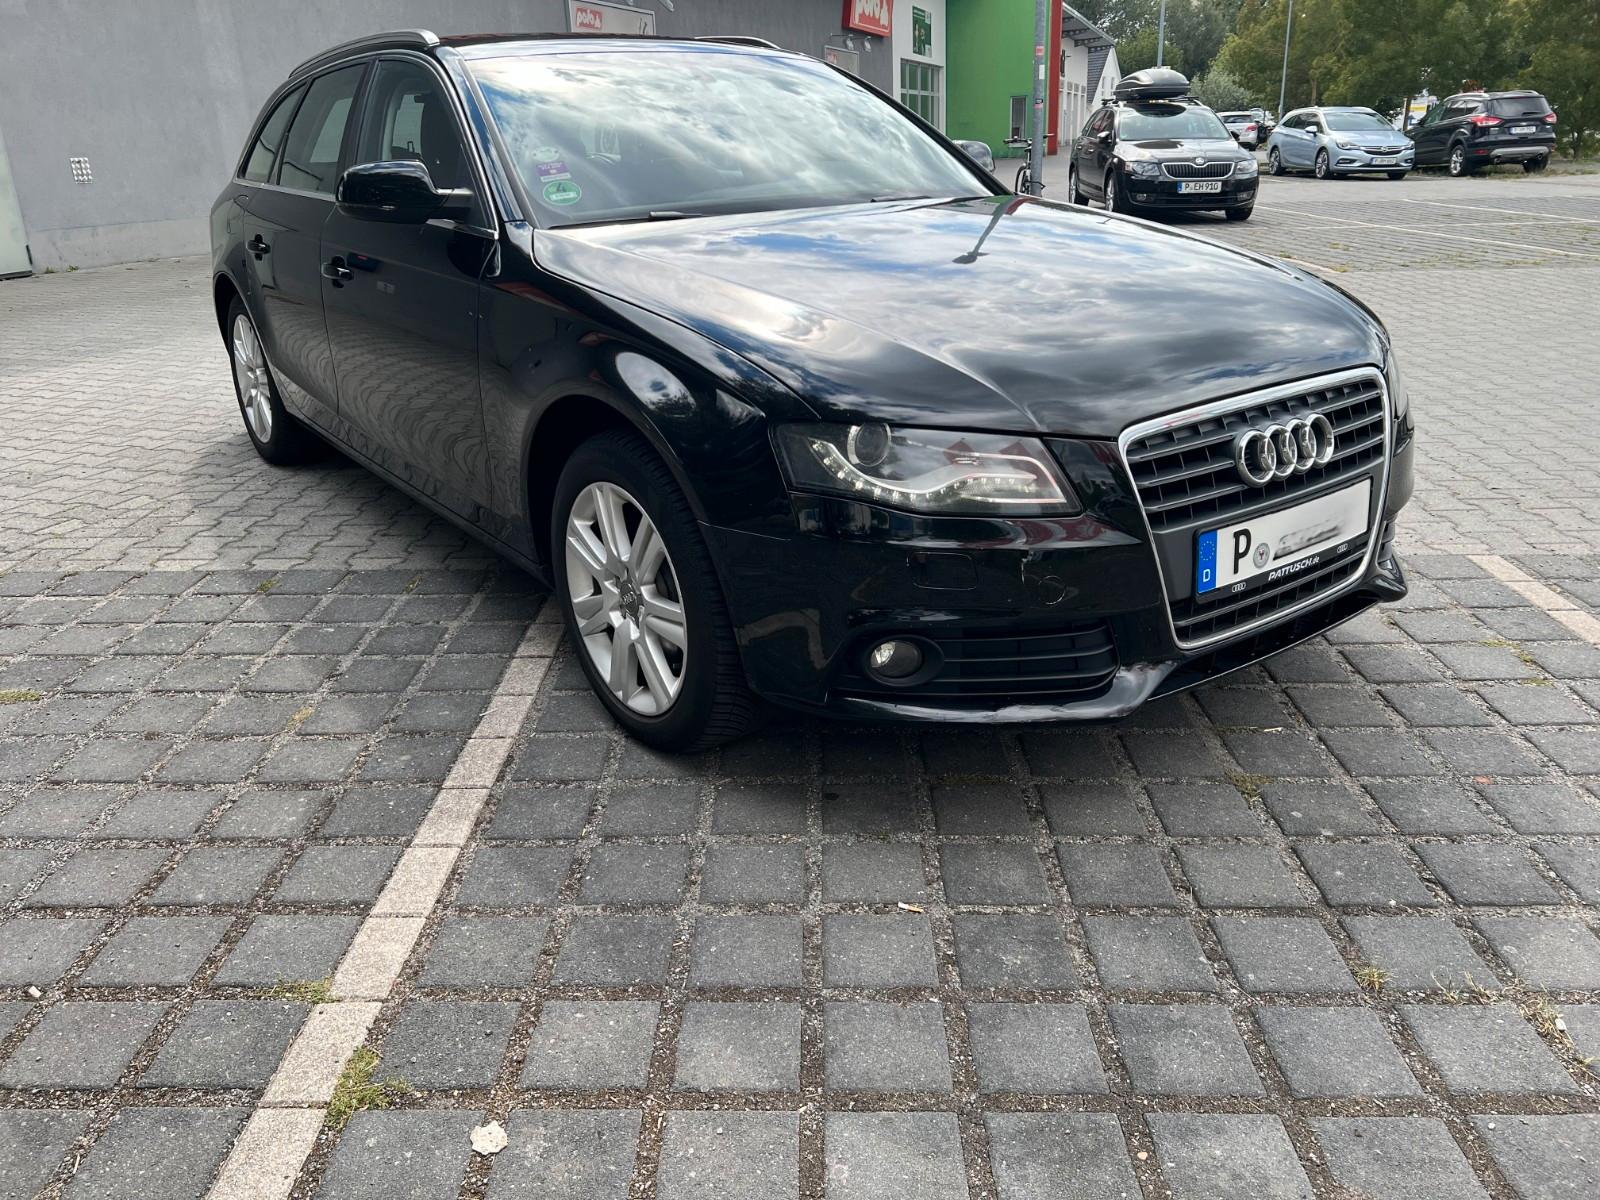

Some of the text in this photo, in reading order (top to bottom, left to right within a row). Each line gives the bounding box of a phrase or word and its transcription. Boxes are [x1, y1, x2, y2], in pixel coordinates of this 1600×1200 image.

[1205, 182, 1219, 191] 910
[1233, 528, 1252, 575] P
[1202, 569, 1211, 583] D
[1268, 556, 1320, 581] PATTUSCH.de
